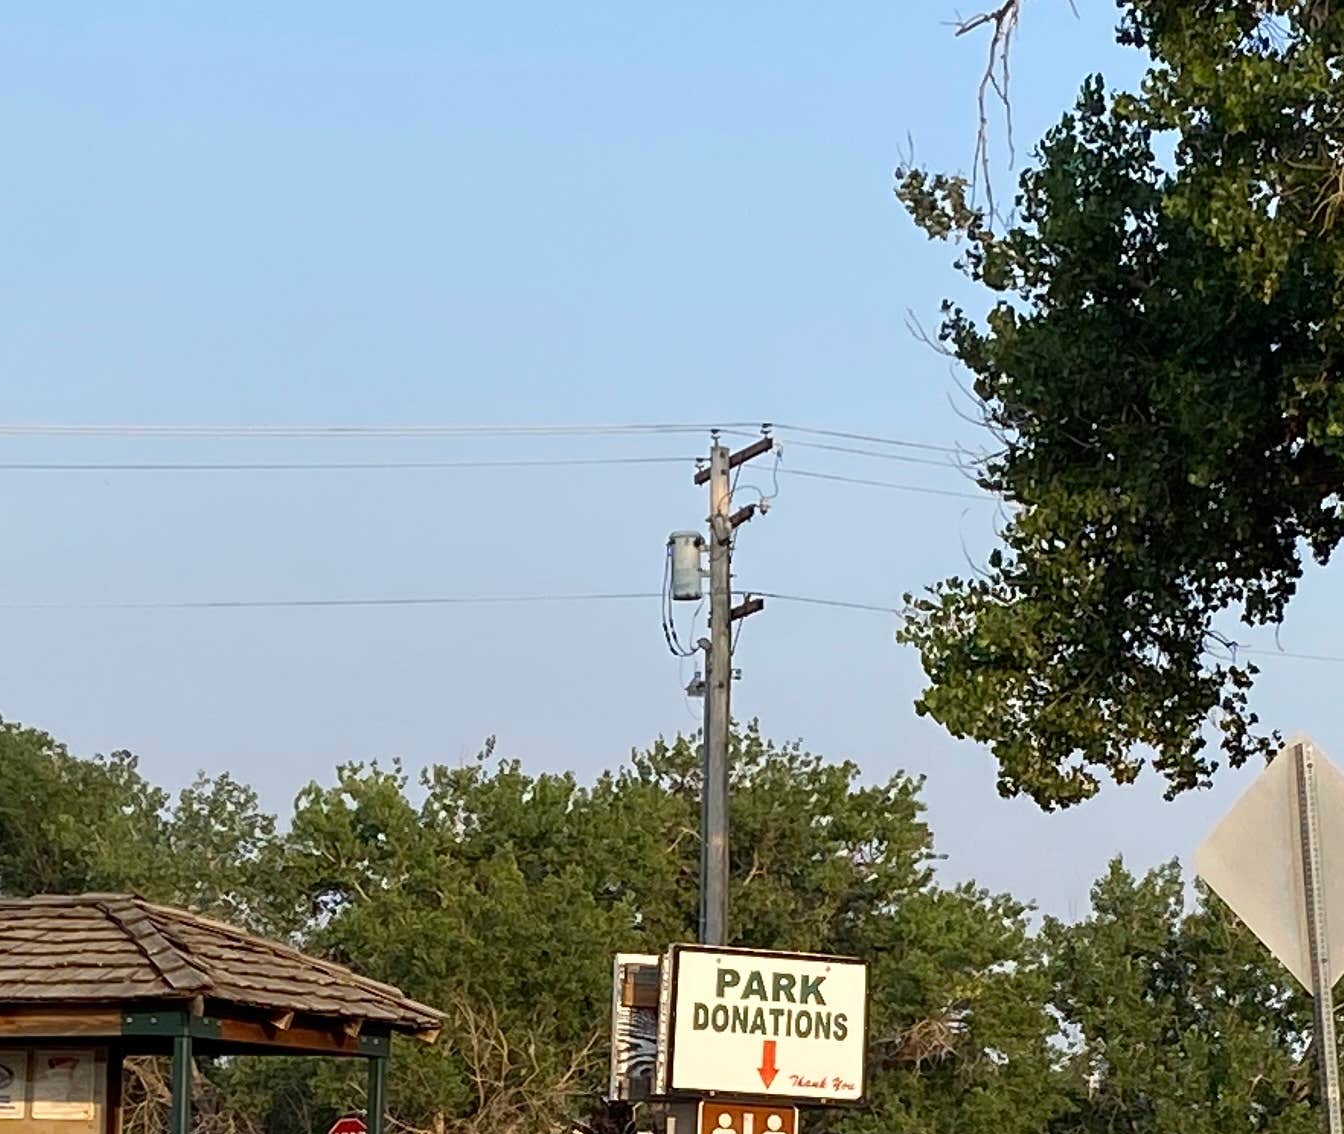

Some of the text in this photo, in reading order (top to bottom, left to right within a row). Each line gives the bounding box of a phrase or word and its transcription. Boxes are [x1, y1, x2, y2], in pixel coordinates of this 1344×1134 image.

[716, 968, 826, 1005] PARK
[693, 1002, 848, 1041] DONATIONS
[789, 1075, 855, 1092] Thank You
